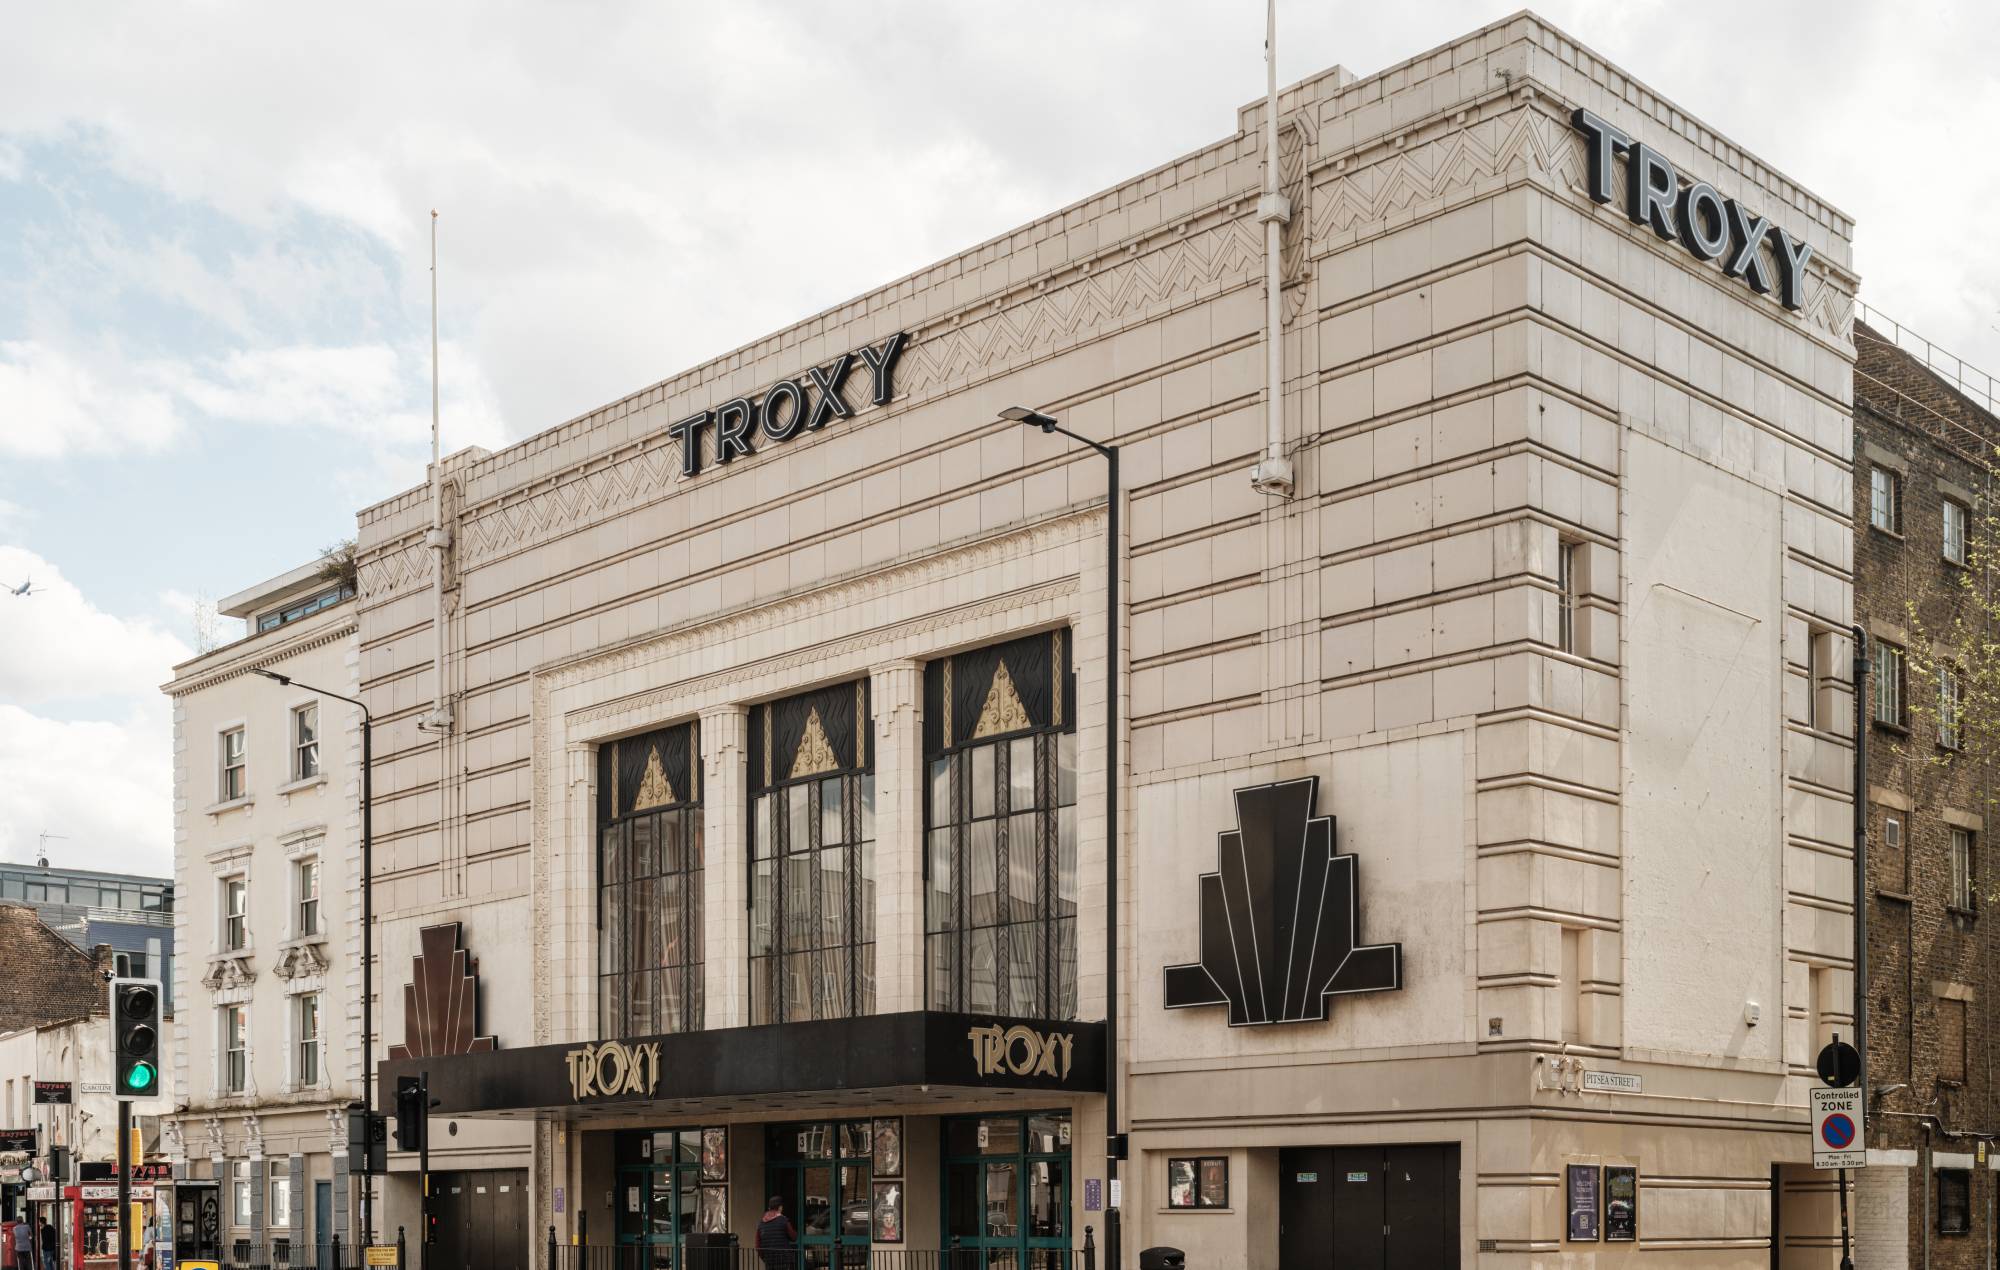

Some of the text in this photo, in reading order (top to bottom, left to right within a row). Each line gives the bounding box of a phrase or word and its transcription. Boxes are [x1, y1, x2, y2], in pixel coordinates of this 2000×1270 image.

[1572, 107, 1814, 311] TROXY
[669, 331, 908, 477] TROXY
[967, 1023, 1074, 1082] TROXY
[565, 1041, 661, 1102] TROXY
[1586, 1073, 1610, 1086] PITSEA
[1610, 1076, 1635, 1088] STREET
[1814, 1091, 1859, 1100] Controlled
[1821, 1101, 1853, 1111] ZONE
[799, 1135, 805, 1148] 3
